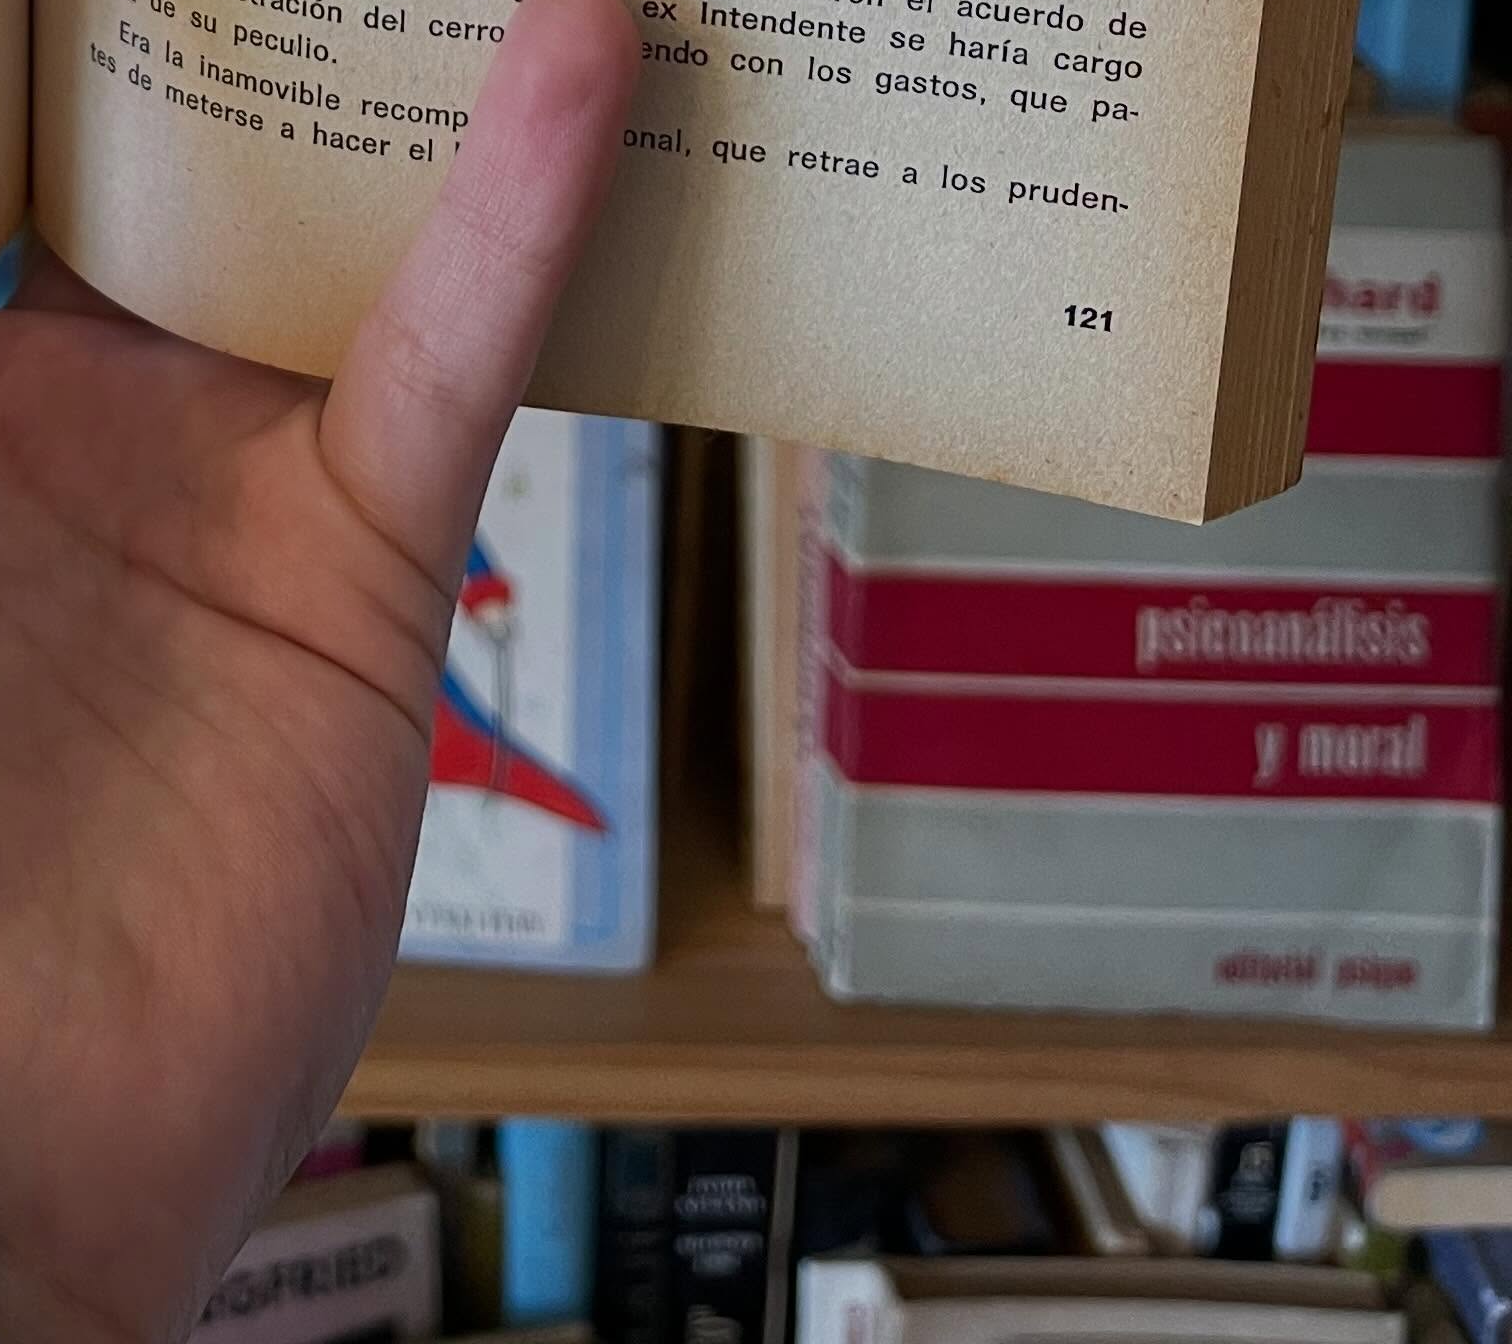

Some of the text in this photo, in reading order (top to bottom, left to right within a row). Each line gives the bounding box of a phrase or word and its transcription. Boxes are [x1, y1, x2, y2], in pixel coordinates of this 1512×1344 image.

[189, 9, 218, 35] su
[232, 22, 338, 65] peculio.
[1063, 303, 1114, 334] 121
[1138, 597, 1430, 670] psicoanálisis
[1253, 714, 1426, 787] y moral
